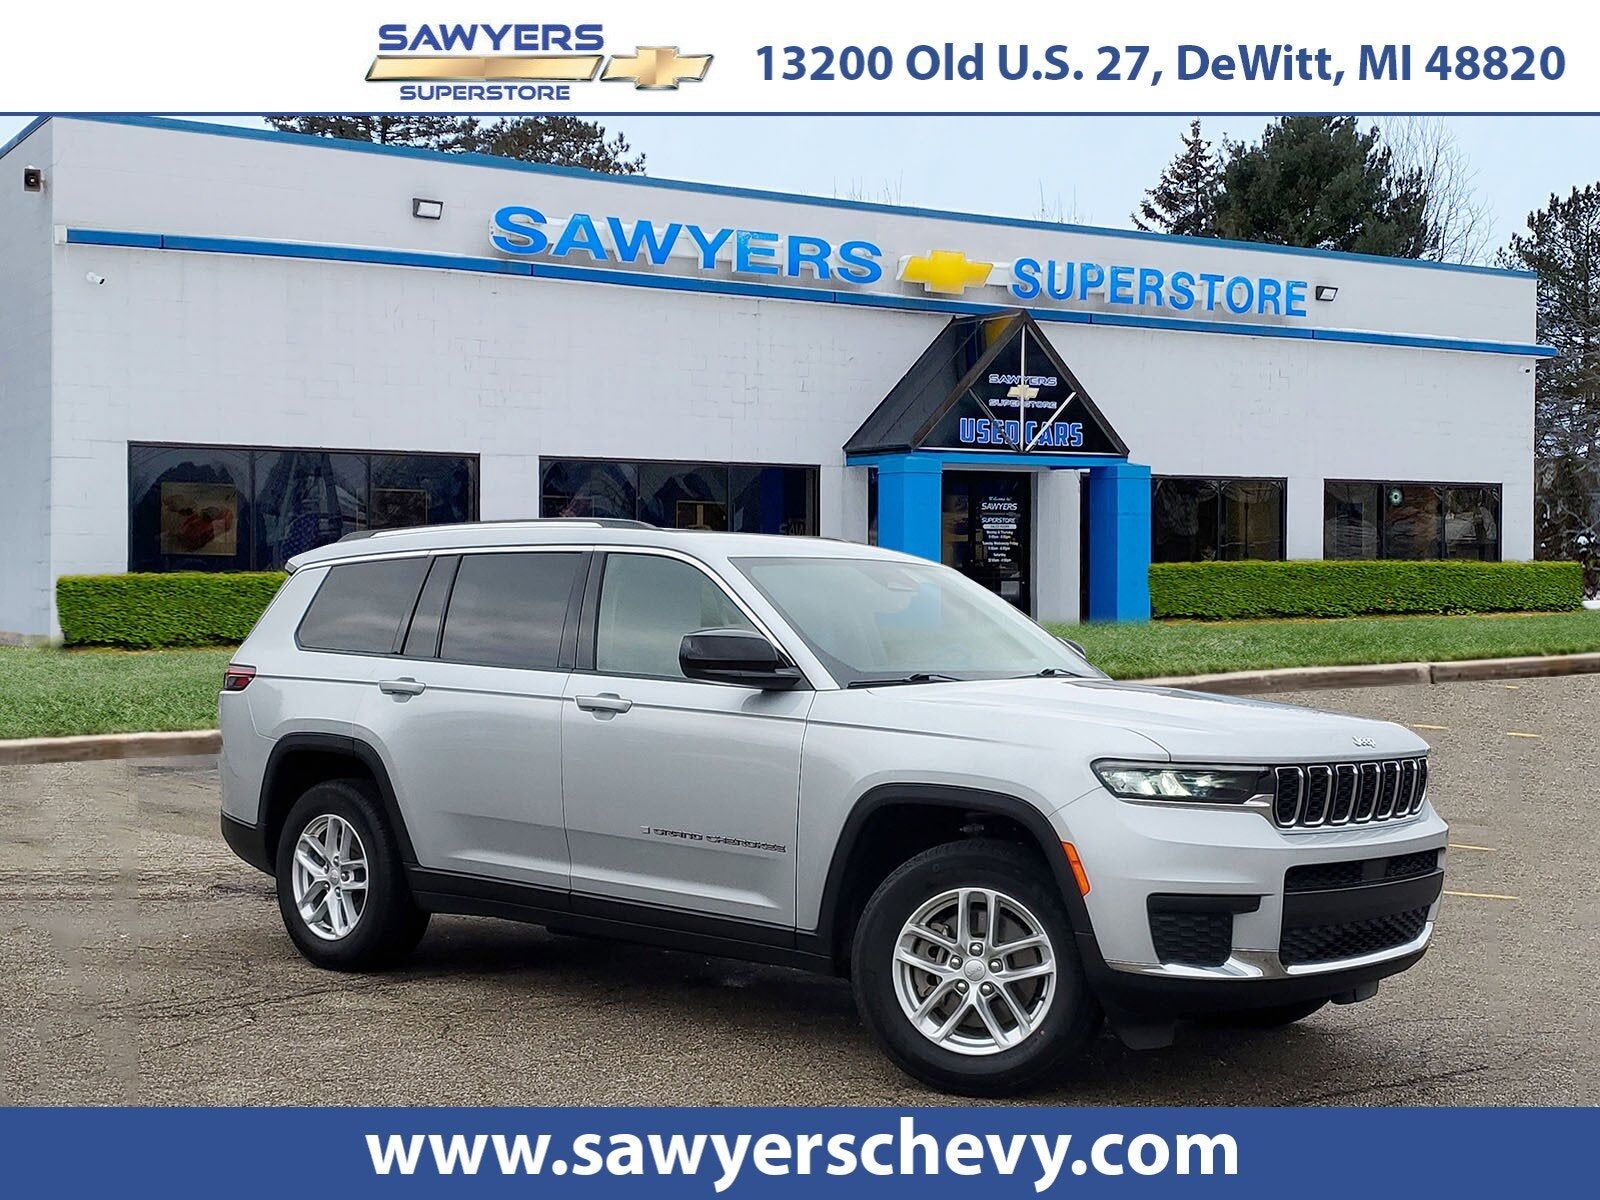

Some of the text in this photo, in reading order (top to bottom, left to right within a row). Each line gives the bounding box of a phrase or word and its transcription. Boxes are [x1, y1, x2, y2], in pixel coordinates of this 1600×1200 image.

[489, 205, 1309, 317] SAWYERS SUPERSTORE
[988, 373, 1058, 387] SAWYERS
[959, 417, 1084, 447] USED CARS
[981, 502, 1018, 511] SAWYERS
[1352, 735, 1376, 751] Jeep
[653, 828, 787, 853] GRAND CHEROKEE
